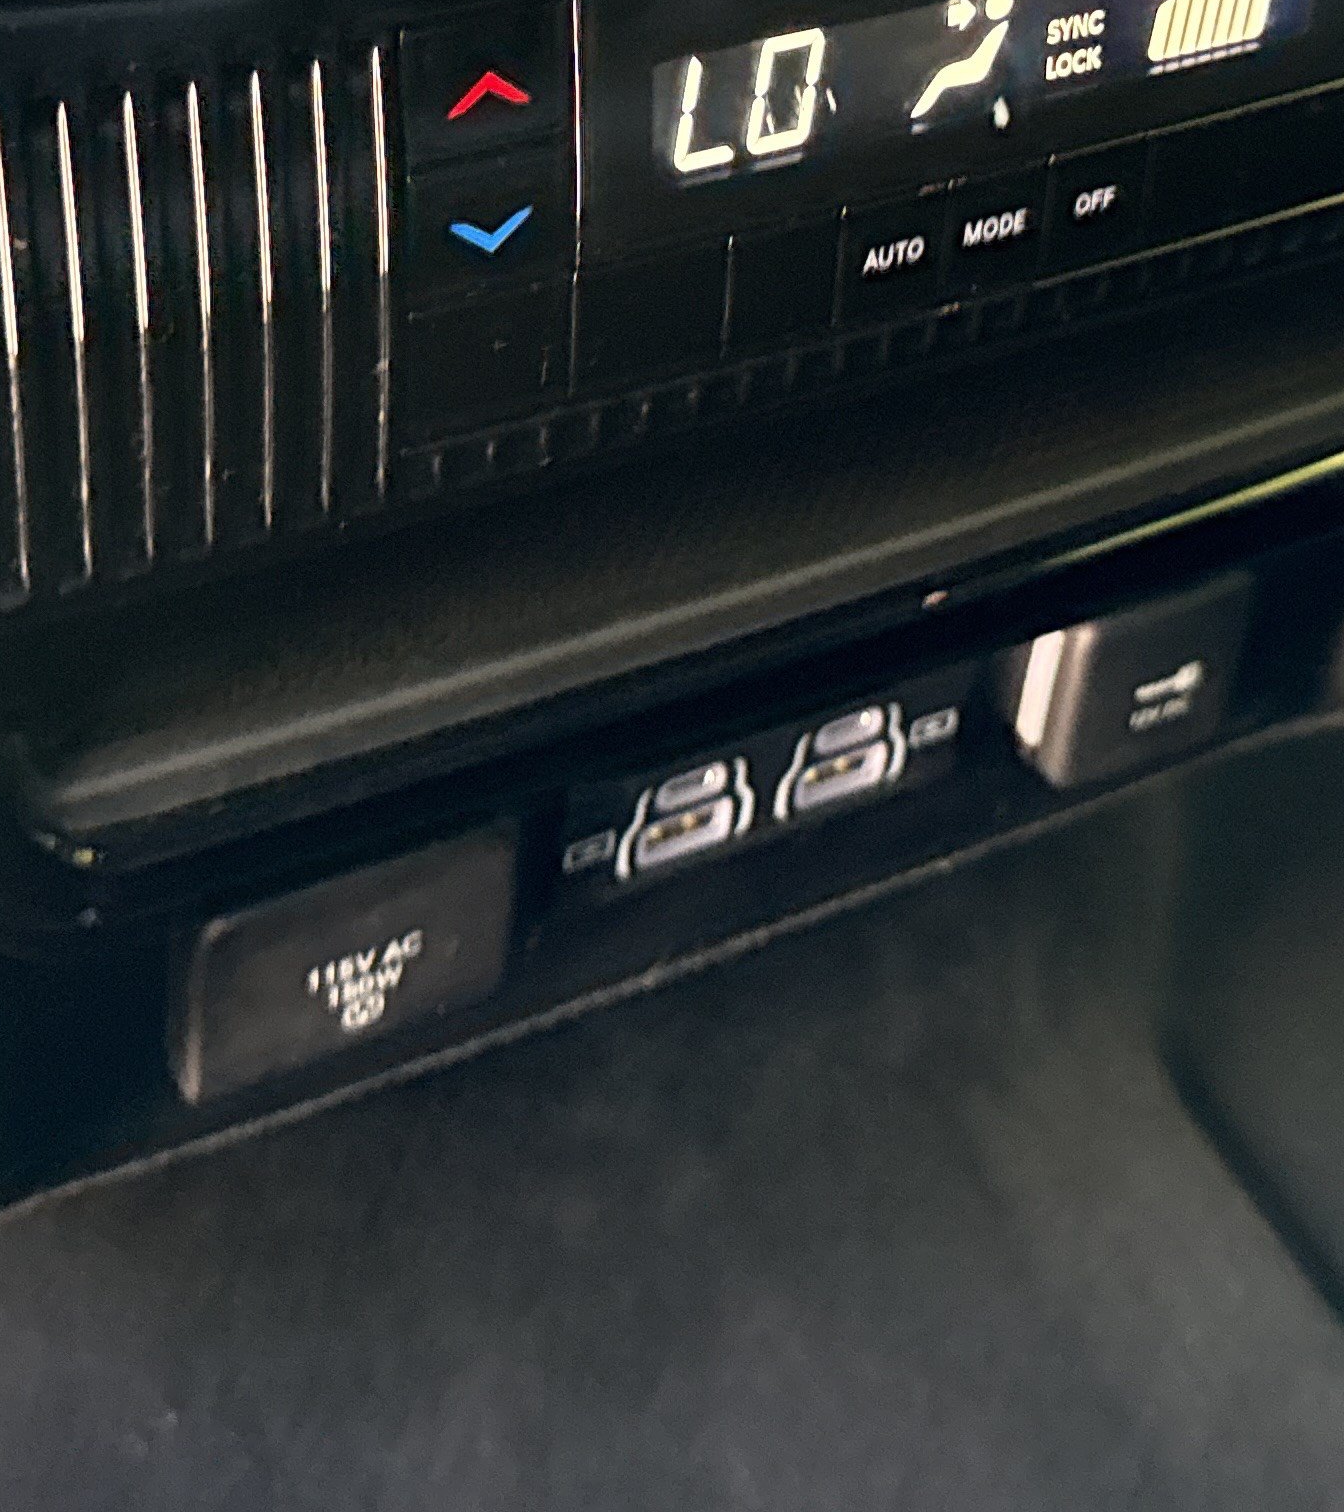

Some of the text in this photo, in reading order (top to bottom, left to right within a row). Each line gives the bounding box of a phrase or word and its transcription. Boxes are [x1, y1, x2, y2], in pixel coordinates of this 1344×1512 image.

[1046, 9, 1106, 45] SYNC
[1045, 44, 1103, 81] LOCK
[1074, 185, 1118, 218] OFF
[962, 207, 1029, 247] MODE
[863, 236, 925, 276] AUTO
